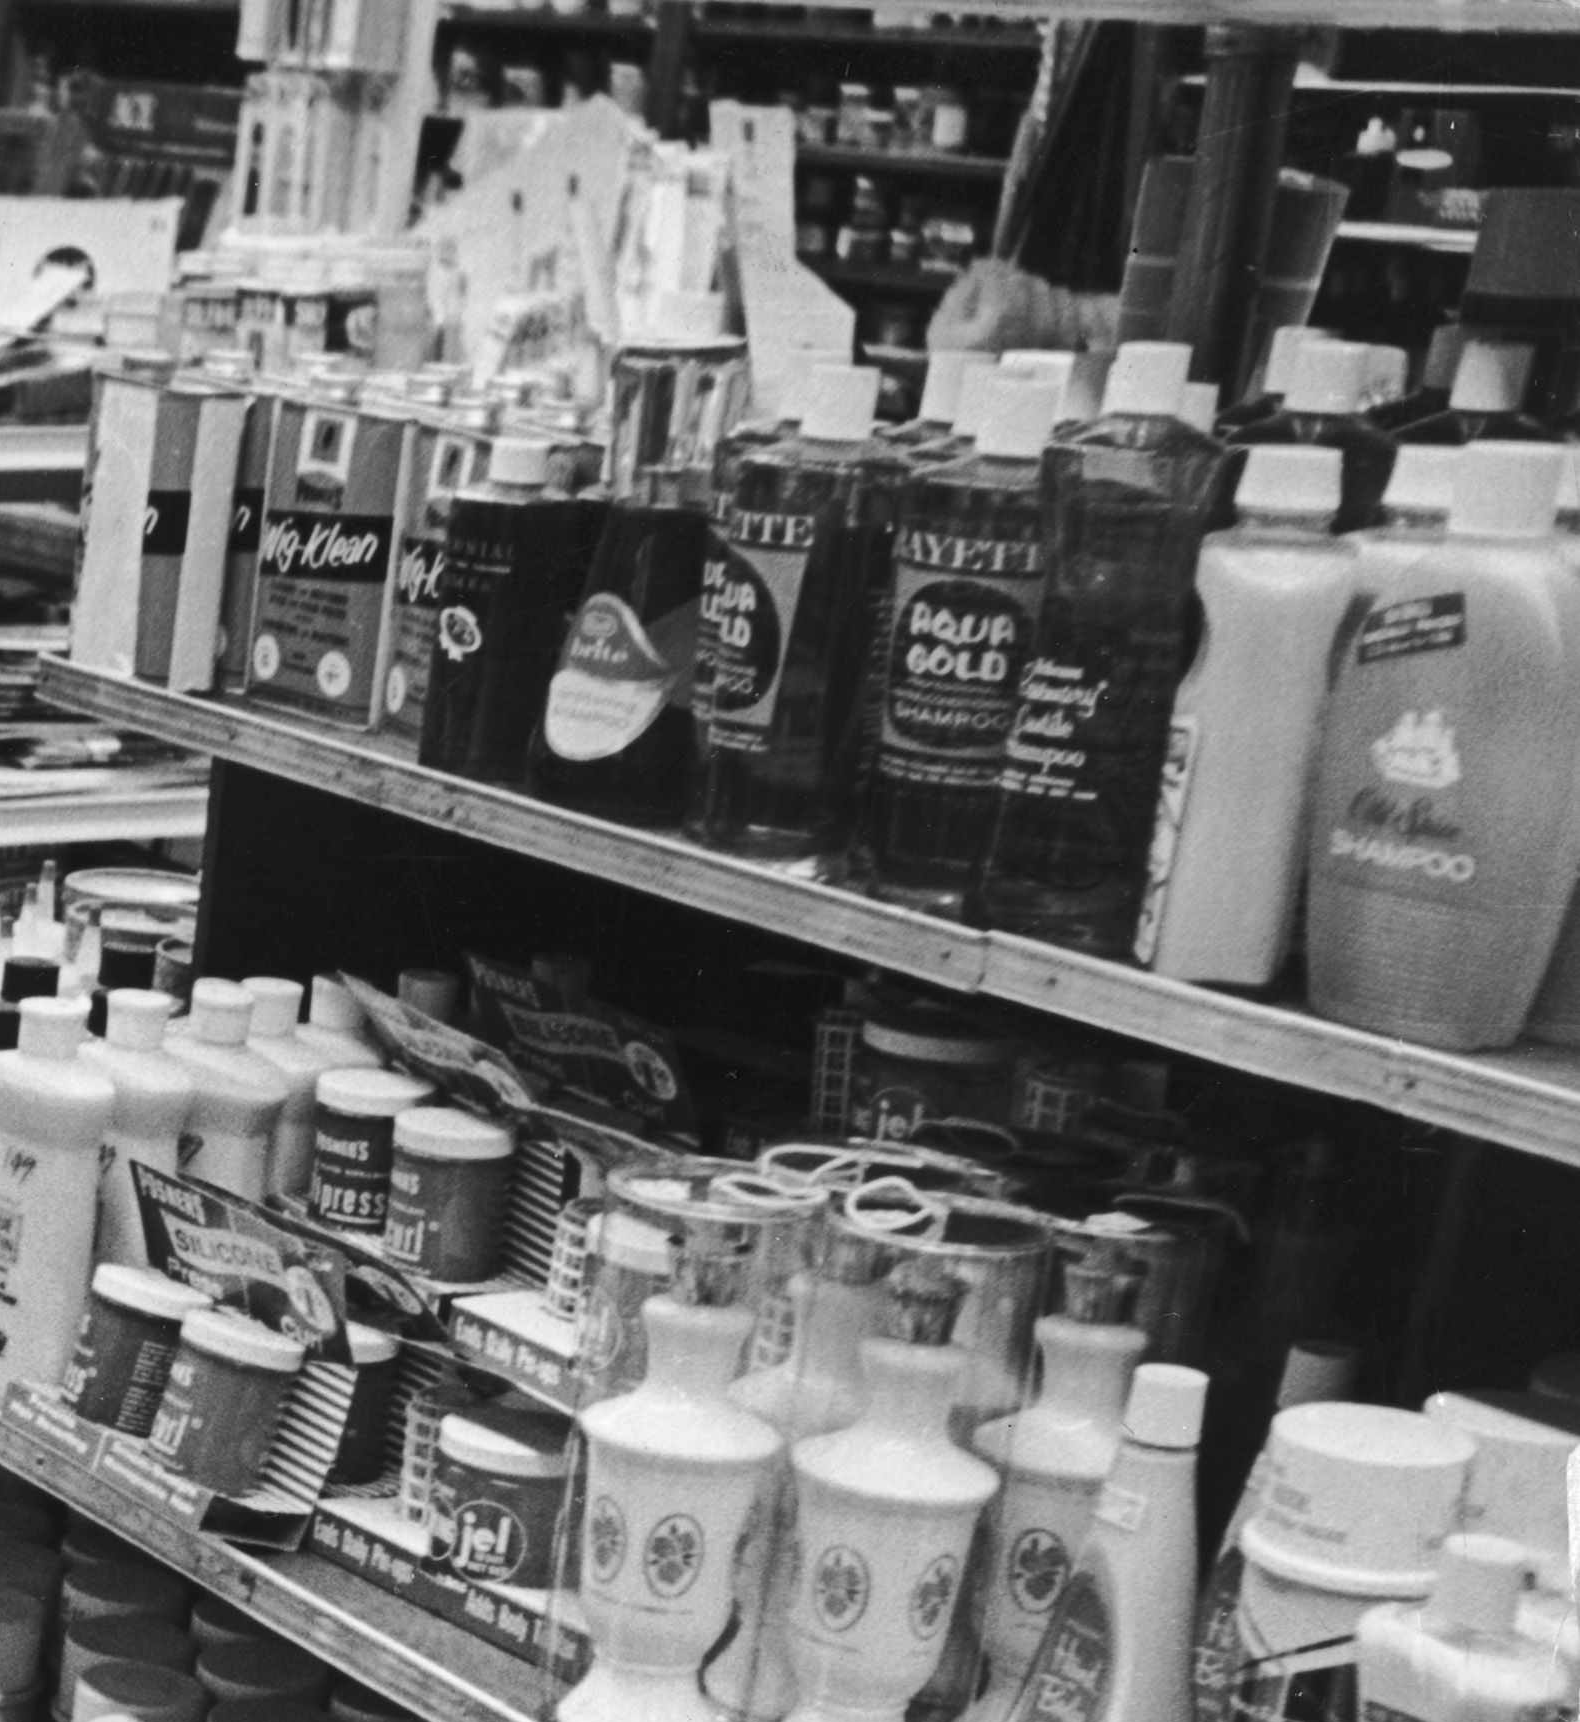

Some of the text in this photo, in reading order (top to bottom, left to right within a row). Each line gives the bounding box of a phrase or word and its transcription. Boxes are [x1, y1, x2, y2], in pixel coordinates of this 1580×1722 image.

[263, 518, 380, 574] Wig-Klean
[909, 600, 1016, 646] AQUA
[905, 642, 1008, 682] GOLD
[893, 700, 1011, 729] SHAMPOO
[452, 1510, 512, 1569] jel
